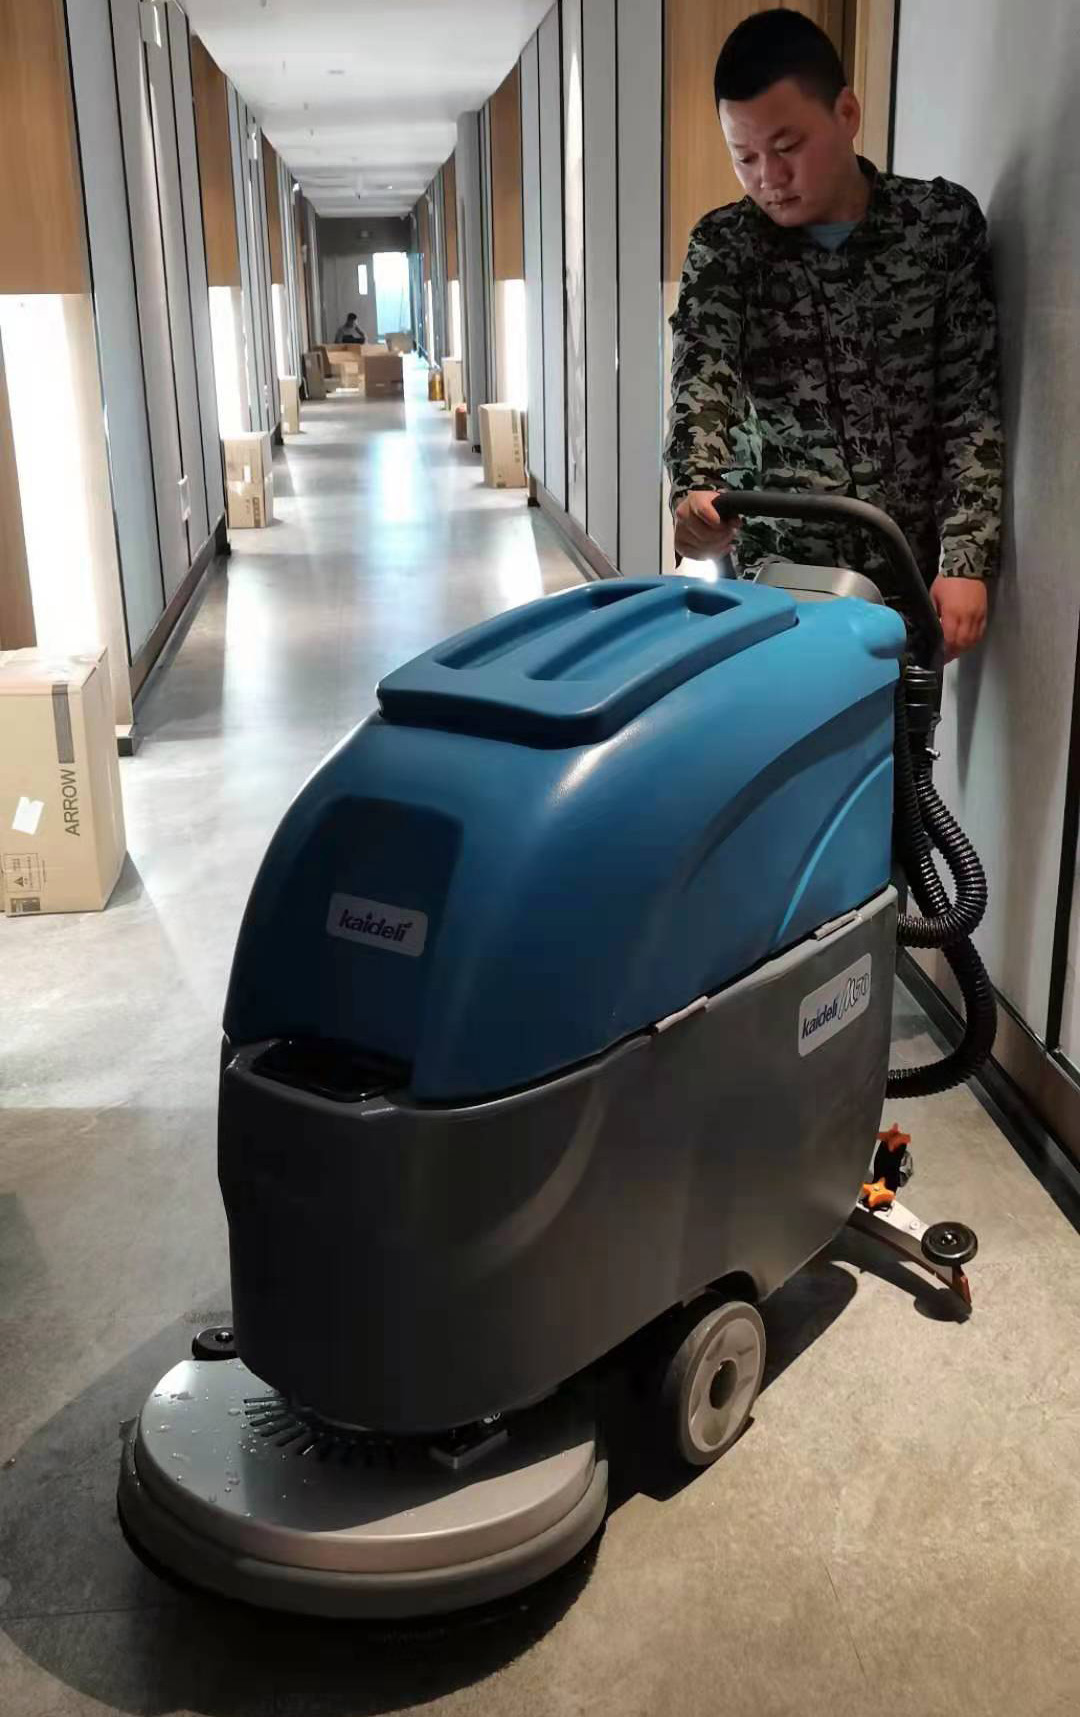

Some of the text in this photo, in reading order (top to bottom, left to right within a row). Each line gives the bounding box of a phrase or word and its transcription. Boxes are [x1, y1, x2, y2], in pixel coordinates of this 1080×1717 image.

[60, 768, 81, 836] ARROW
[338, 908, 414, 942] kaideli
[801, 997, 839, 1040] kaideli
